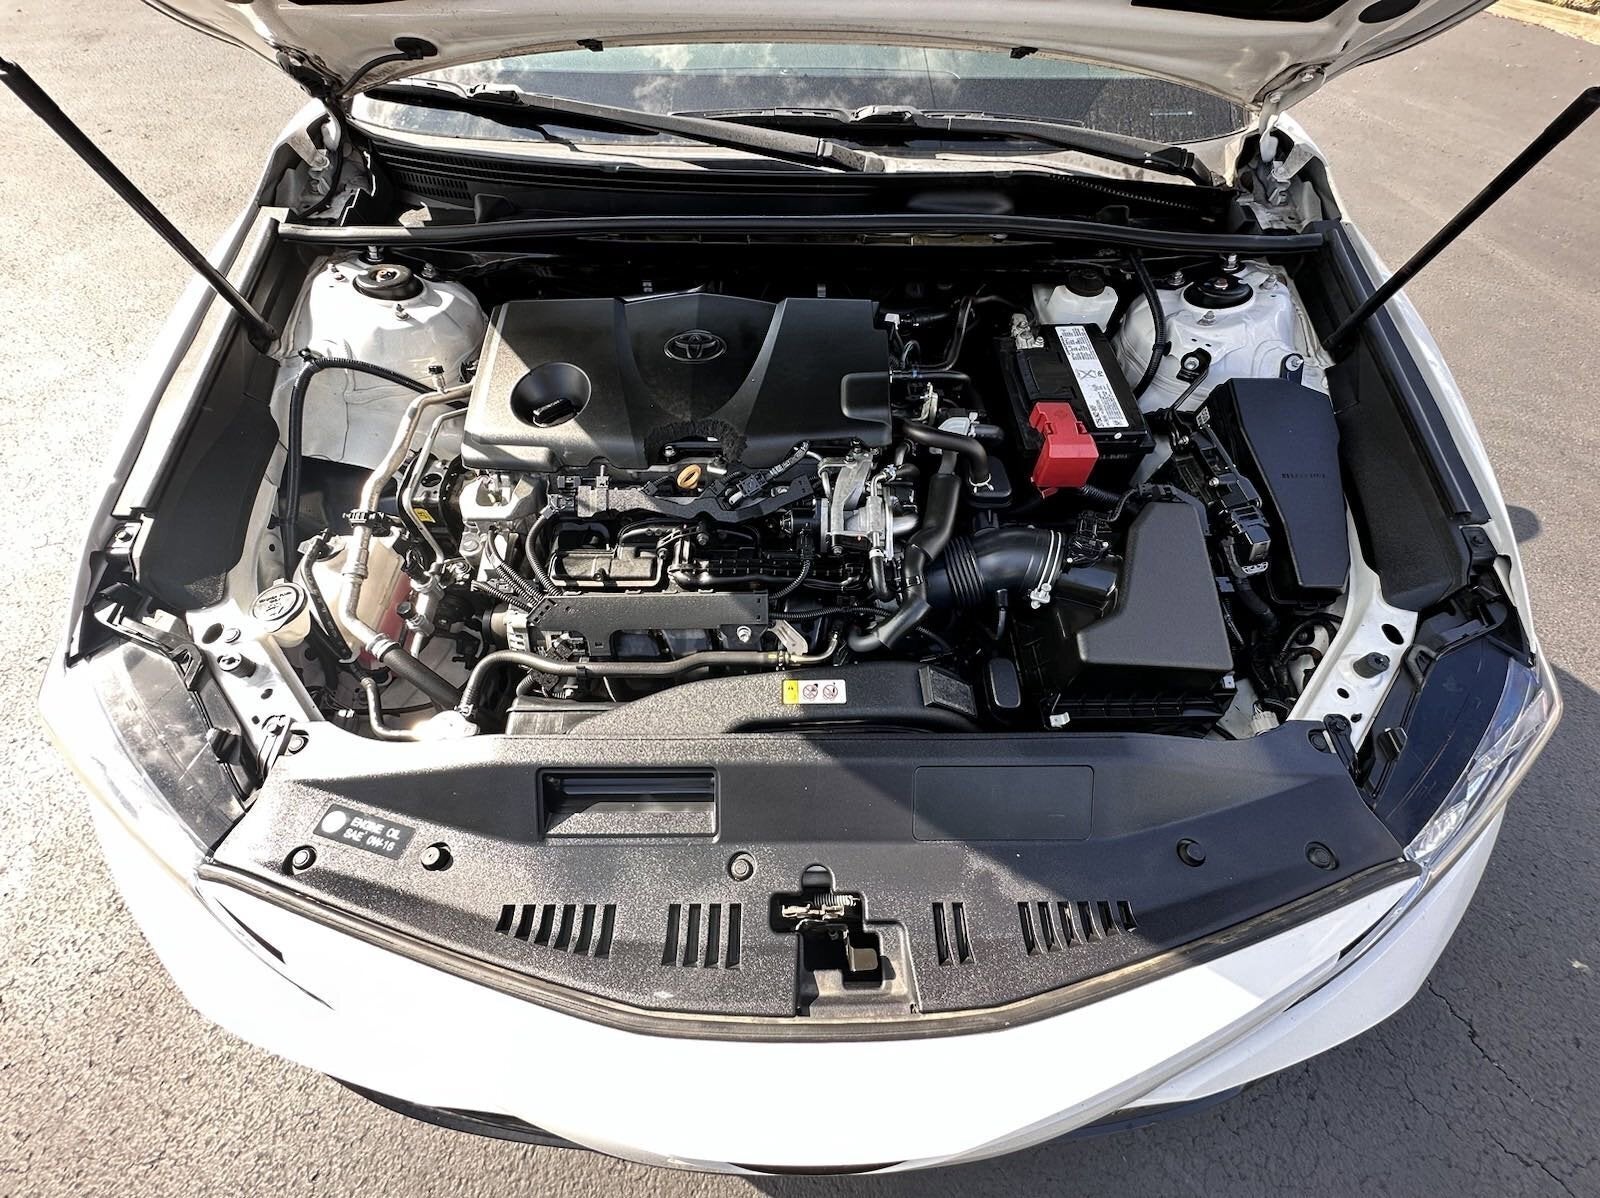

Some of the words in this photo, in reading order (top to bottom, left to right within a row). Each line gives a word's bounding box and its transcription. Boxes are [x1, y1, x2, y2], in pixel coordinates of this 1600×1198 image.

[343, 828, 364, 842] SAE
[350, 816, 385, 834] ENGINE
[386, 828, 401, 840] OIL
